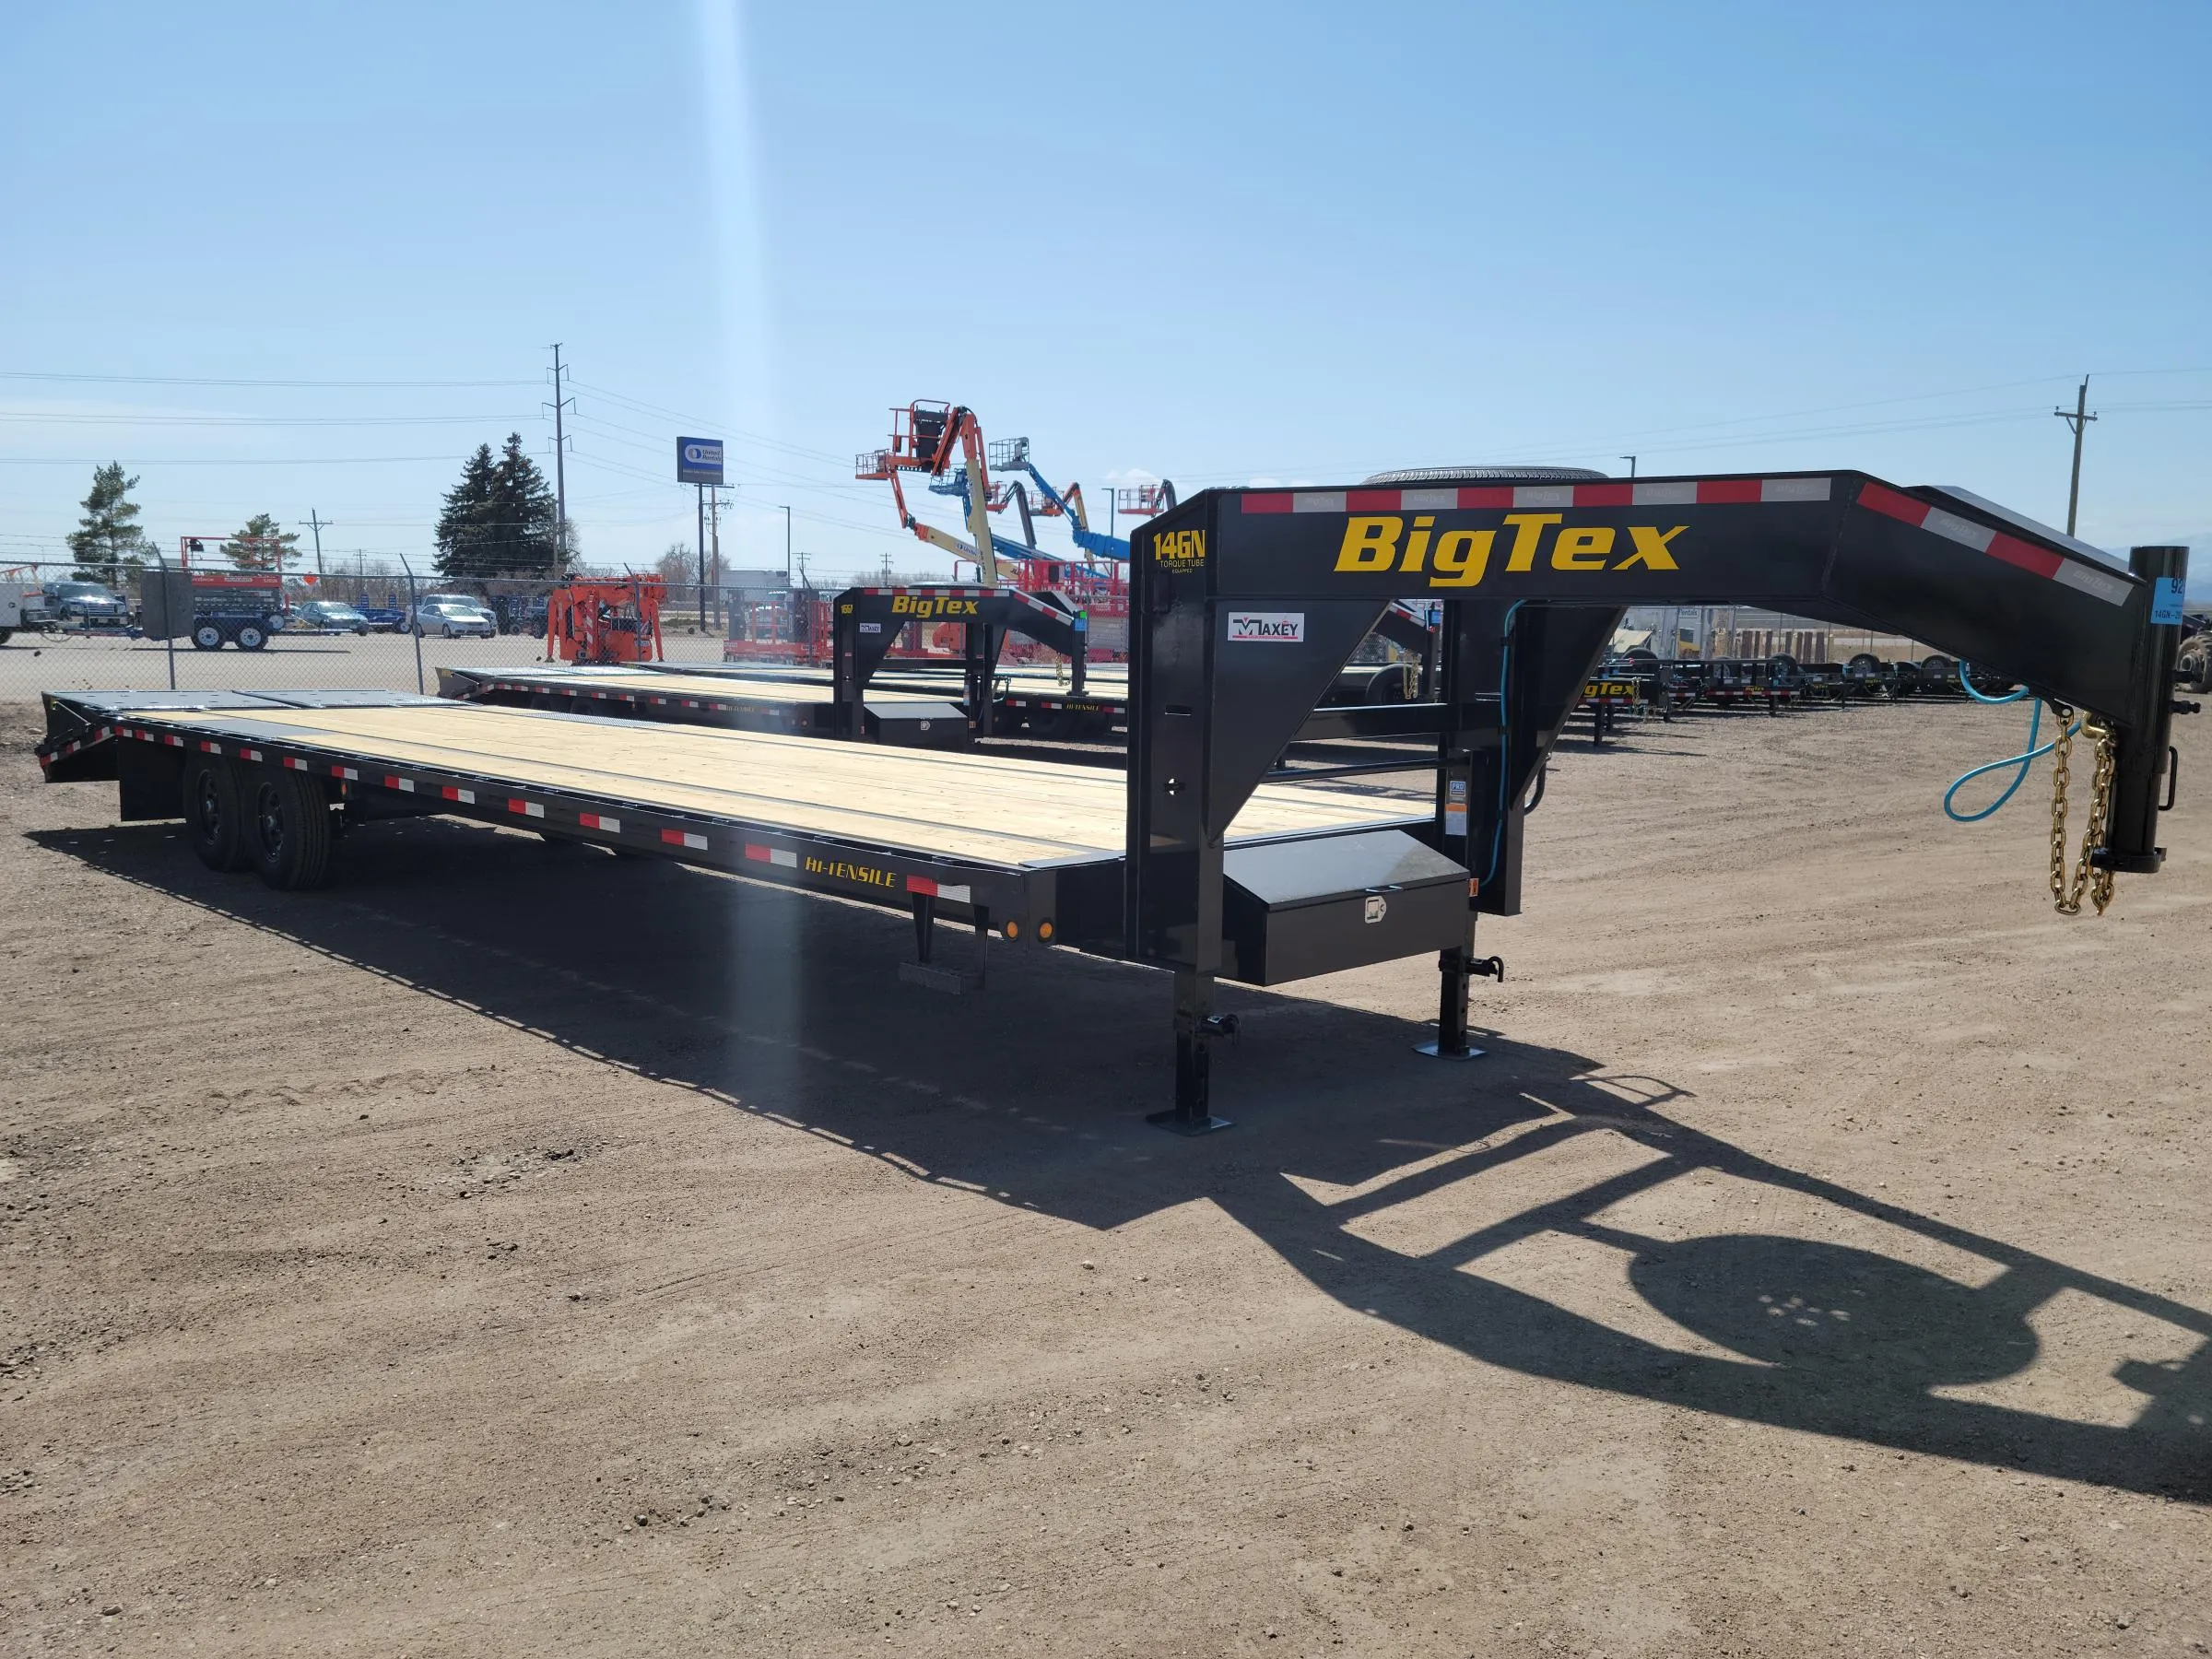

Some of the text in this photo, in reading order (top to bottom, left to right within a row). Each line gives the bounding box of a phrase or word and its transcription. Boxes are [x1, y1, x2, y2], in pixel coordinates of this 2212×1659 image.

[1153, 529, 1206, 560] 14GN
[1334, 513, 1690, 587] BigTex
[1159, 559, 1205, 568] TORQUE TUBE
[891, 595, 980, 618] BigTex
[1232, 617, 1299, 636] MAXEY
[1583, 682, 1634, 698] gTex
[805, 856, 899, 888] HI-TENSILE
